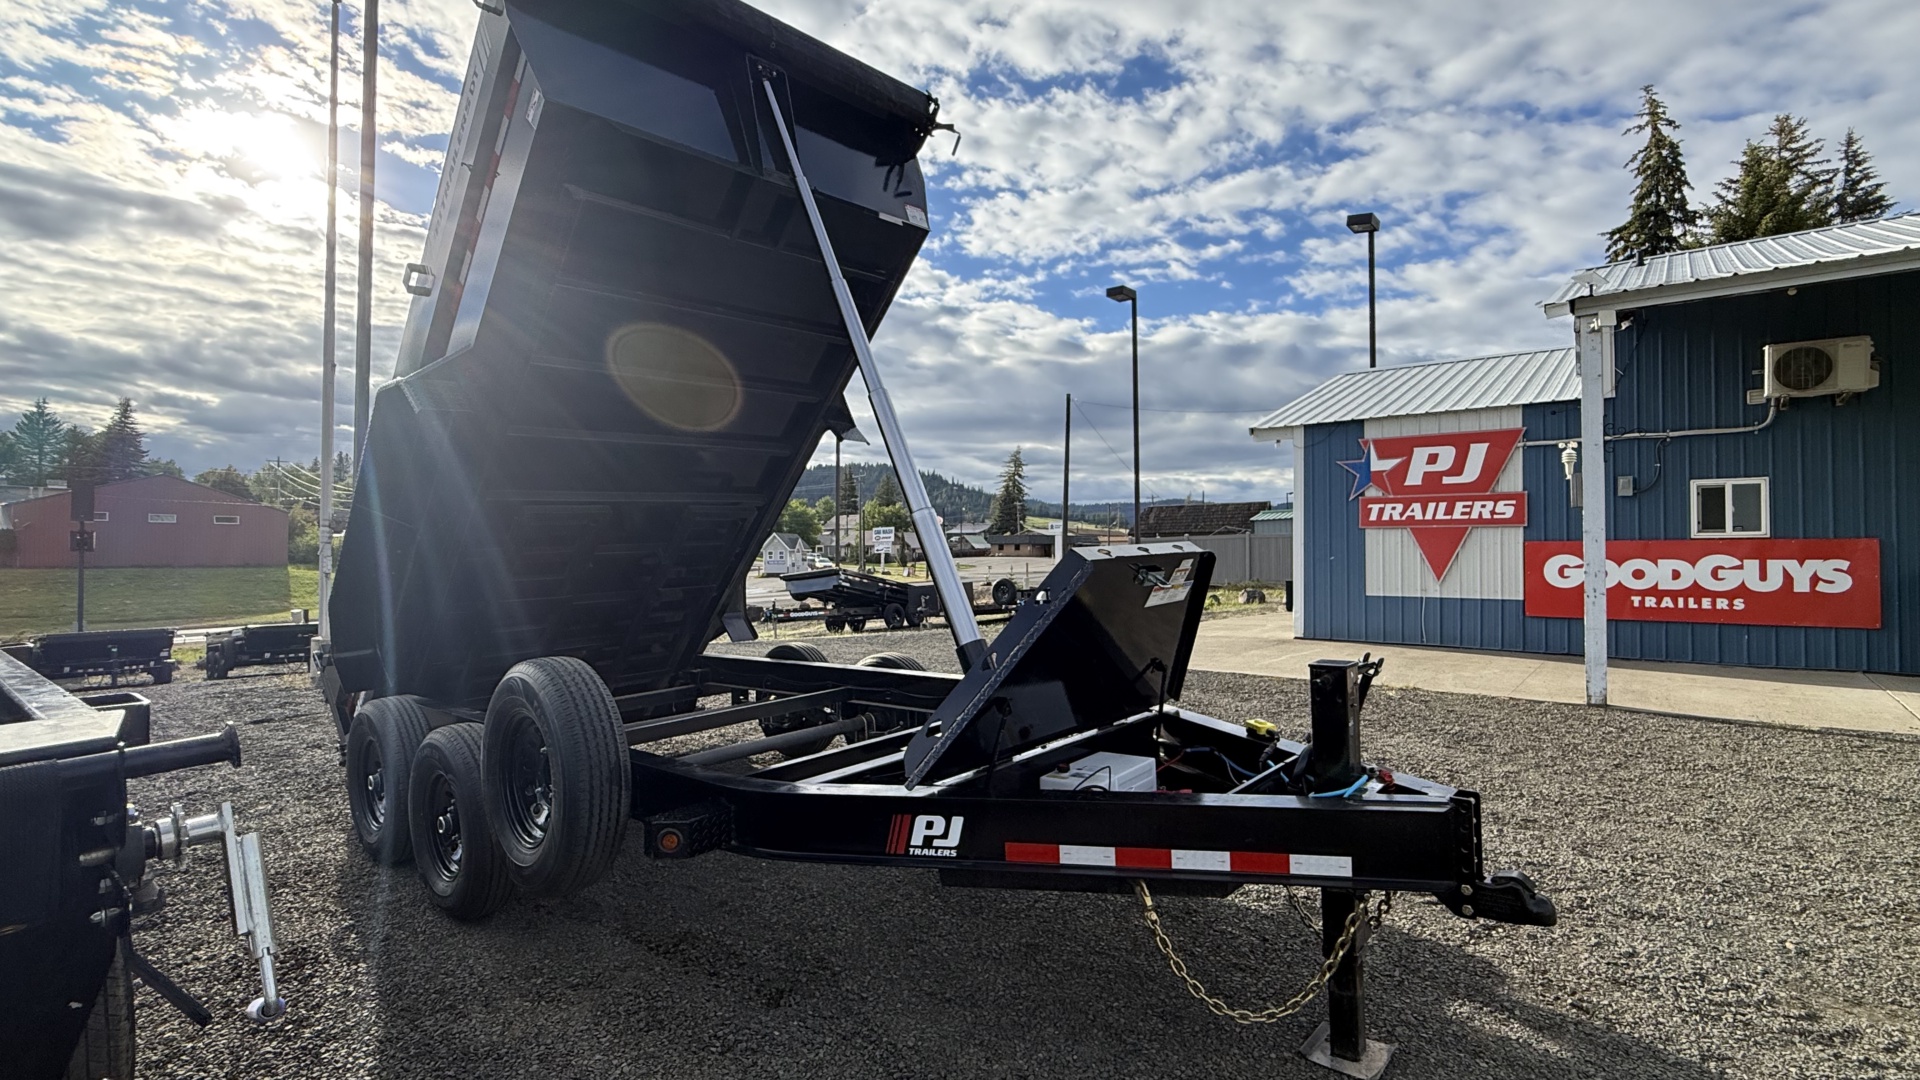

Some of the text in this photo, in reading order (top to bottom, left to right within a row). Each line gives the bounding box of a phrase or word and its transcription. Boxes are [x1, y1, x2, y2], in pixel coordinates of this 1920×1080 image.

[1403, 442, 1490, 486] PJ
[1367, 500, 1517, 521] TRAILERS
[1631, 596, 1745, 610] TRAILERS
[910, 814, 964, 847] PJ
[909, 847, 957, 857] TRAILERS
